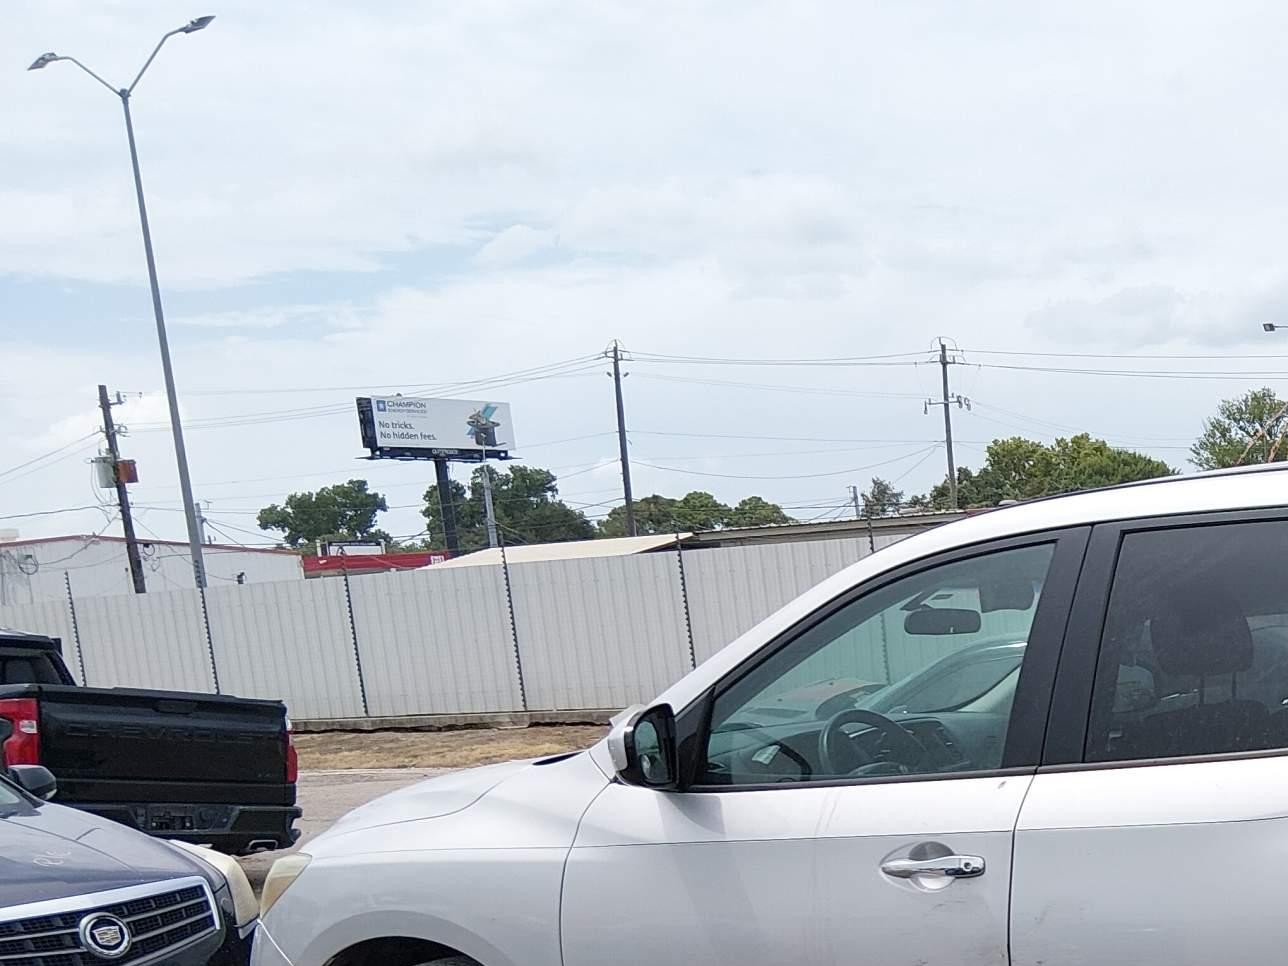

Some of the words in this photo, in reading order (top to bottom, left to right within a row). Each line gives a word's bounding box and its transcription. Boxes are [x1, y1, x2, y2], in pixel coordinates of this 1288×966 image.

[387, 401, 426, 409] CHAMPION
[379, 421, 390, 429] No
[391, 421, 415, 430] tricks.
[380, 431, 391, 439] No
[393, 432, 419, 440] hidden
[420, 432, 437, 441] fees.
